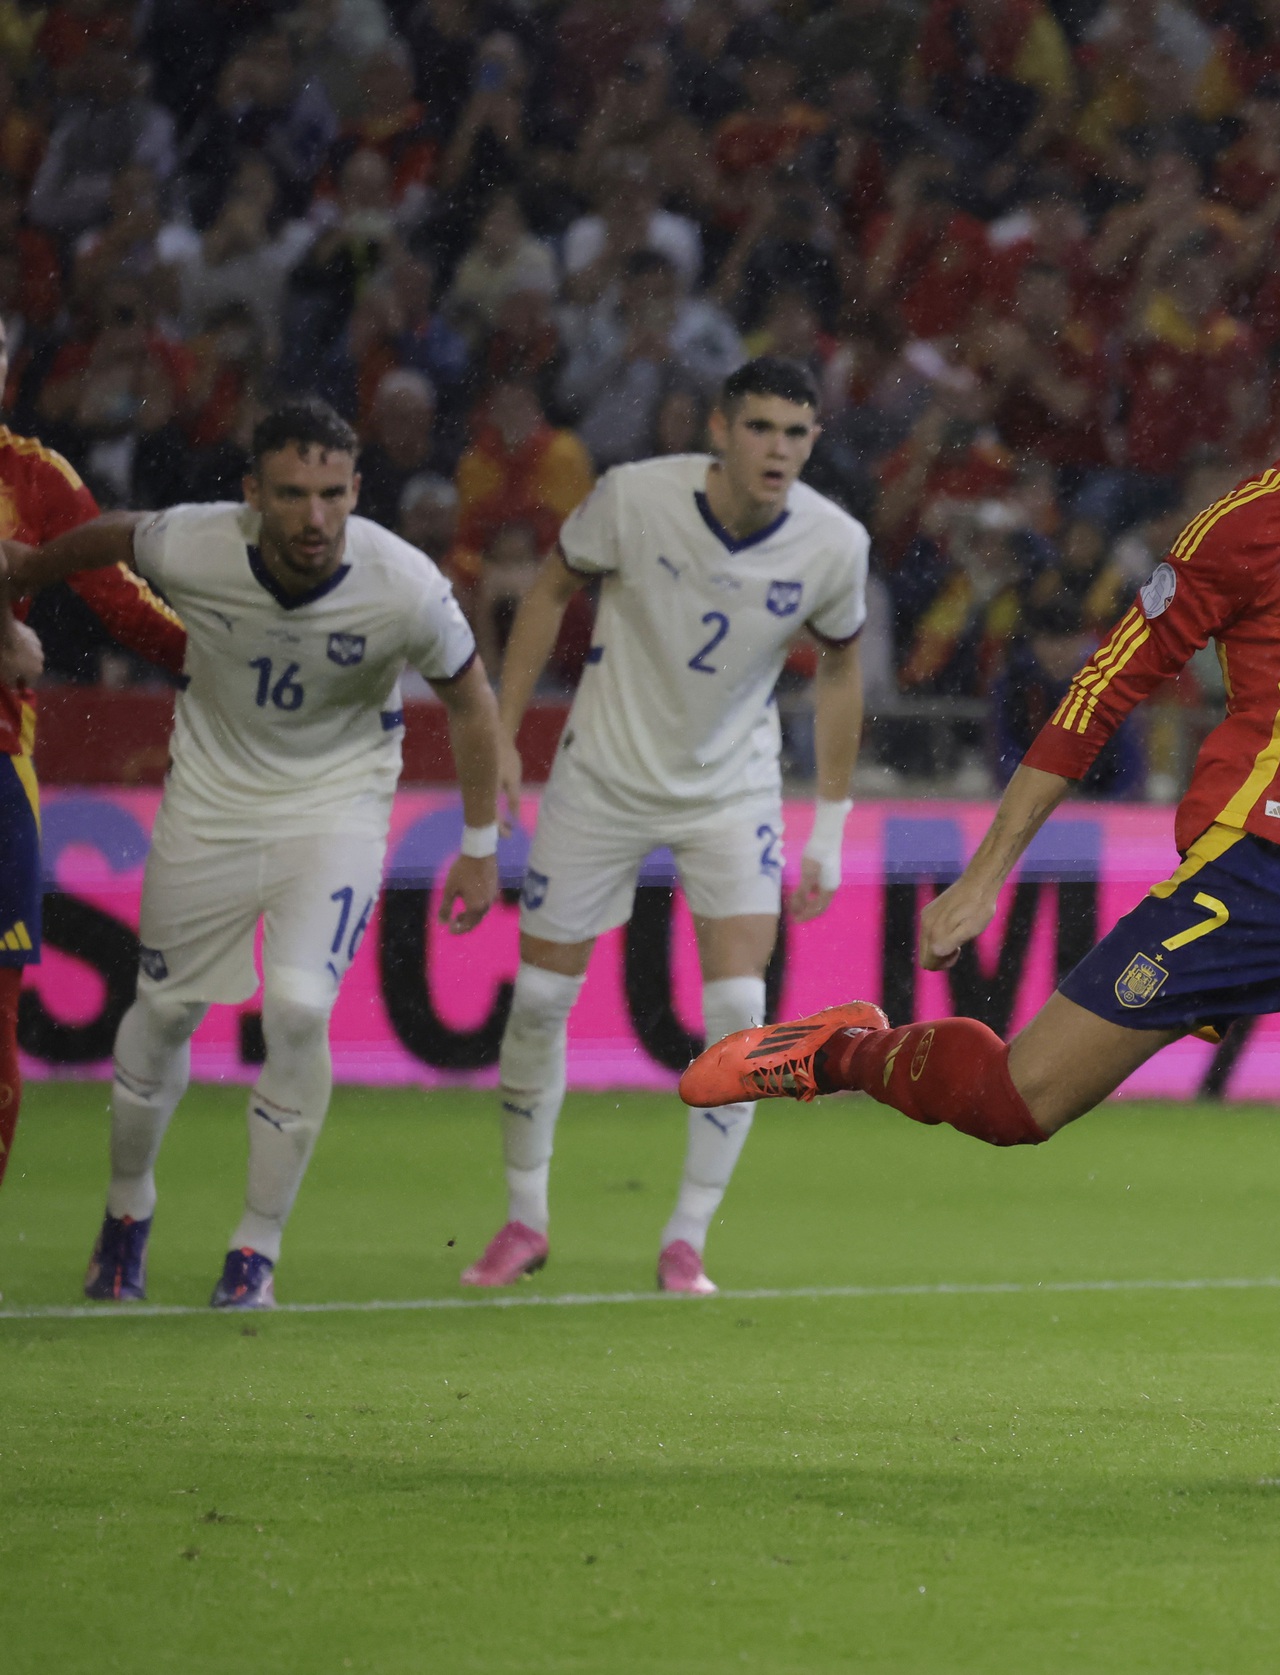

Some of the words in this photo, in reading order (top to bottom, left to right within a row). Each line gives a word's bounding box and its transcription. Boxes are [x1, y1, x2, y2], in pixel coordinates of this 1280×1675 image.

[687, 611, 731, 675] 2
[249, 656, 305, 712] 16
[756, 823, 781, 869] 2
[1161, 891, 1230, 952] 7
